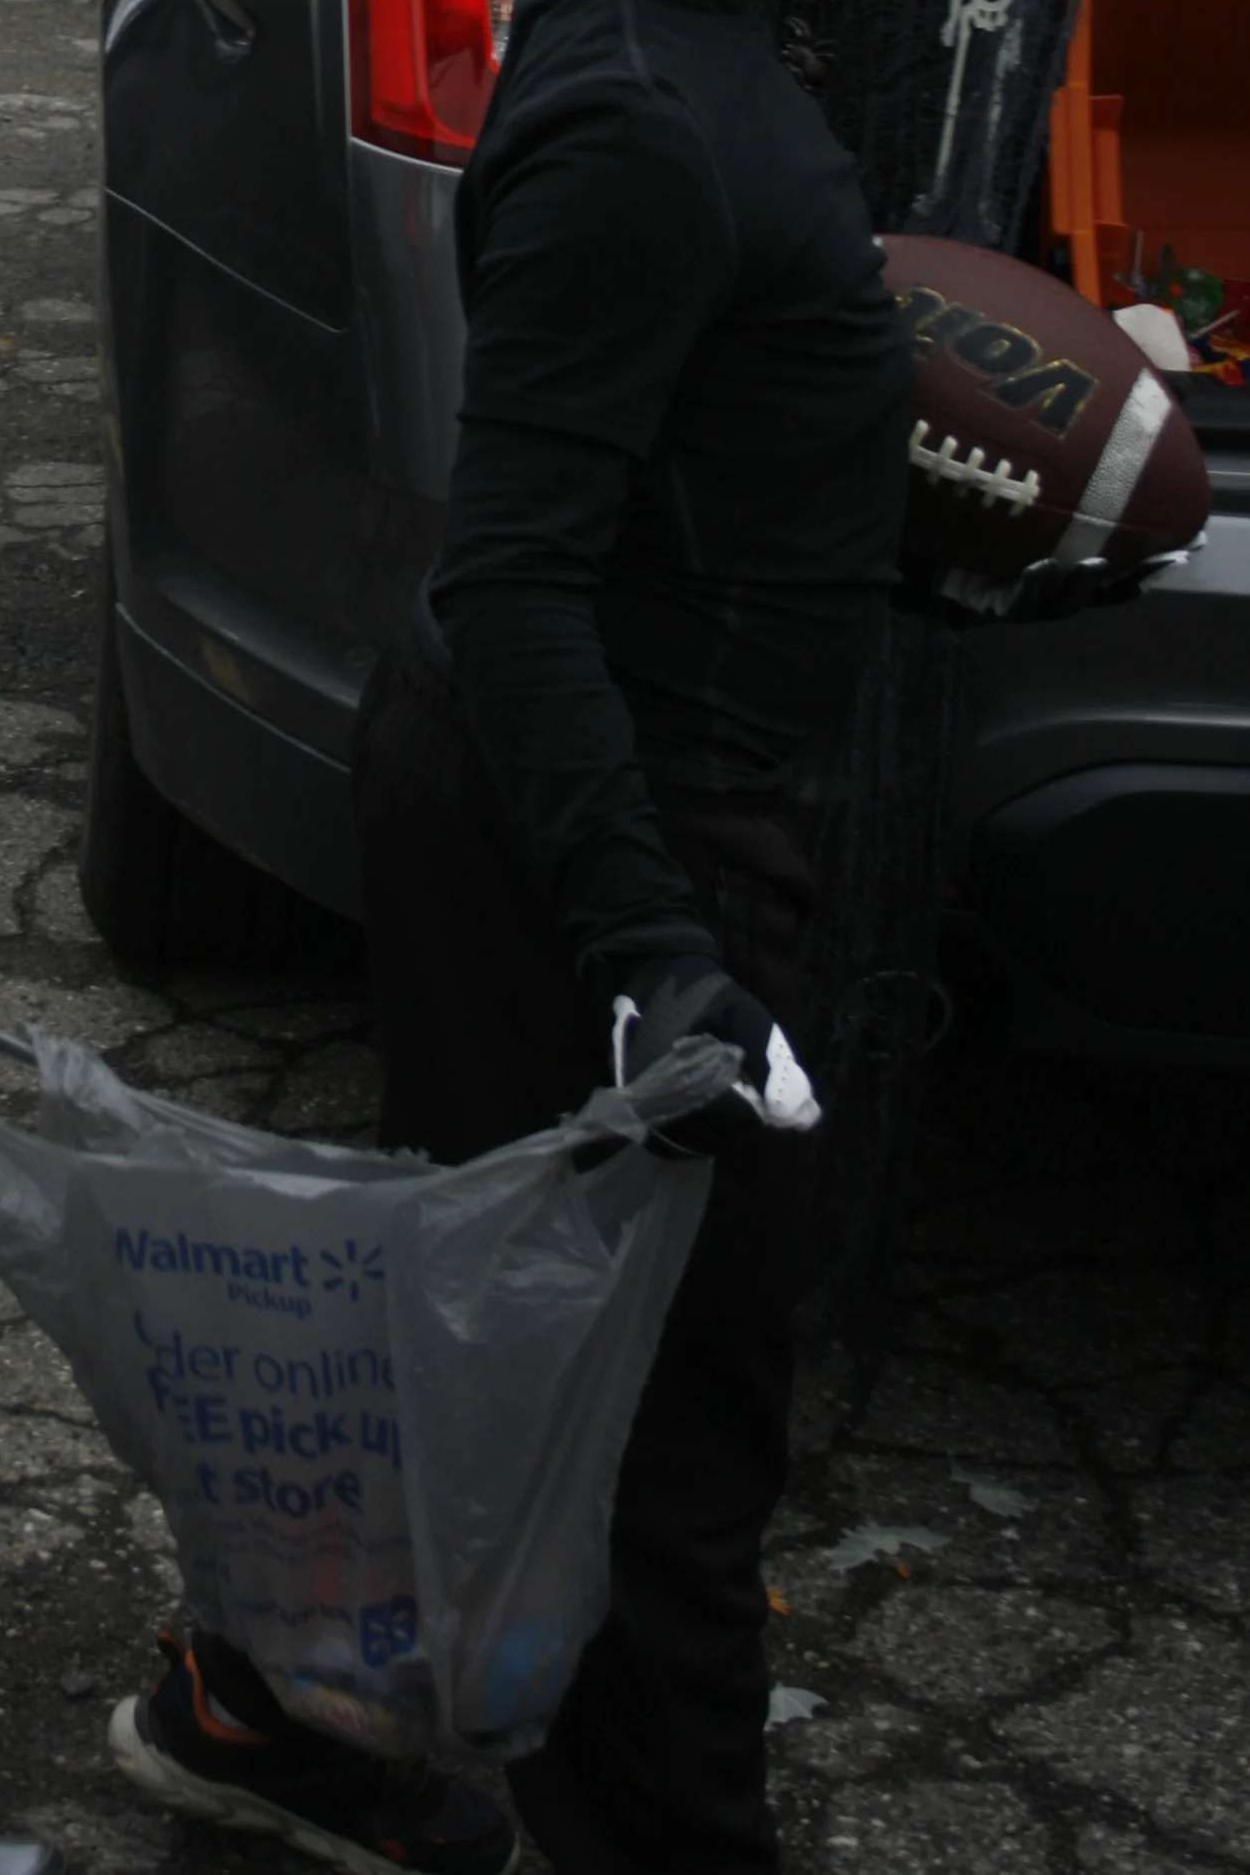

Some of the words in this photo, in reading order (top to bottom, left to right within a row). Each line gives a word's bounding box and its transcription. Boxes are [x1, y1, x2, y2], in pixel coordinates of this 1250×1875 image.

[115, 1226, 311, 1288] Walmart
[226, 1281, 312, 1319] Pickup
[239, 1404, 353, 1460] pick
[231, 1463, 364, 1520] store
